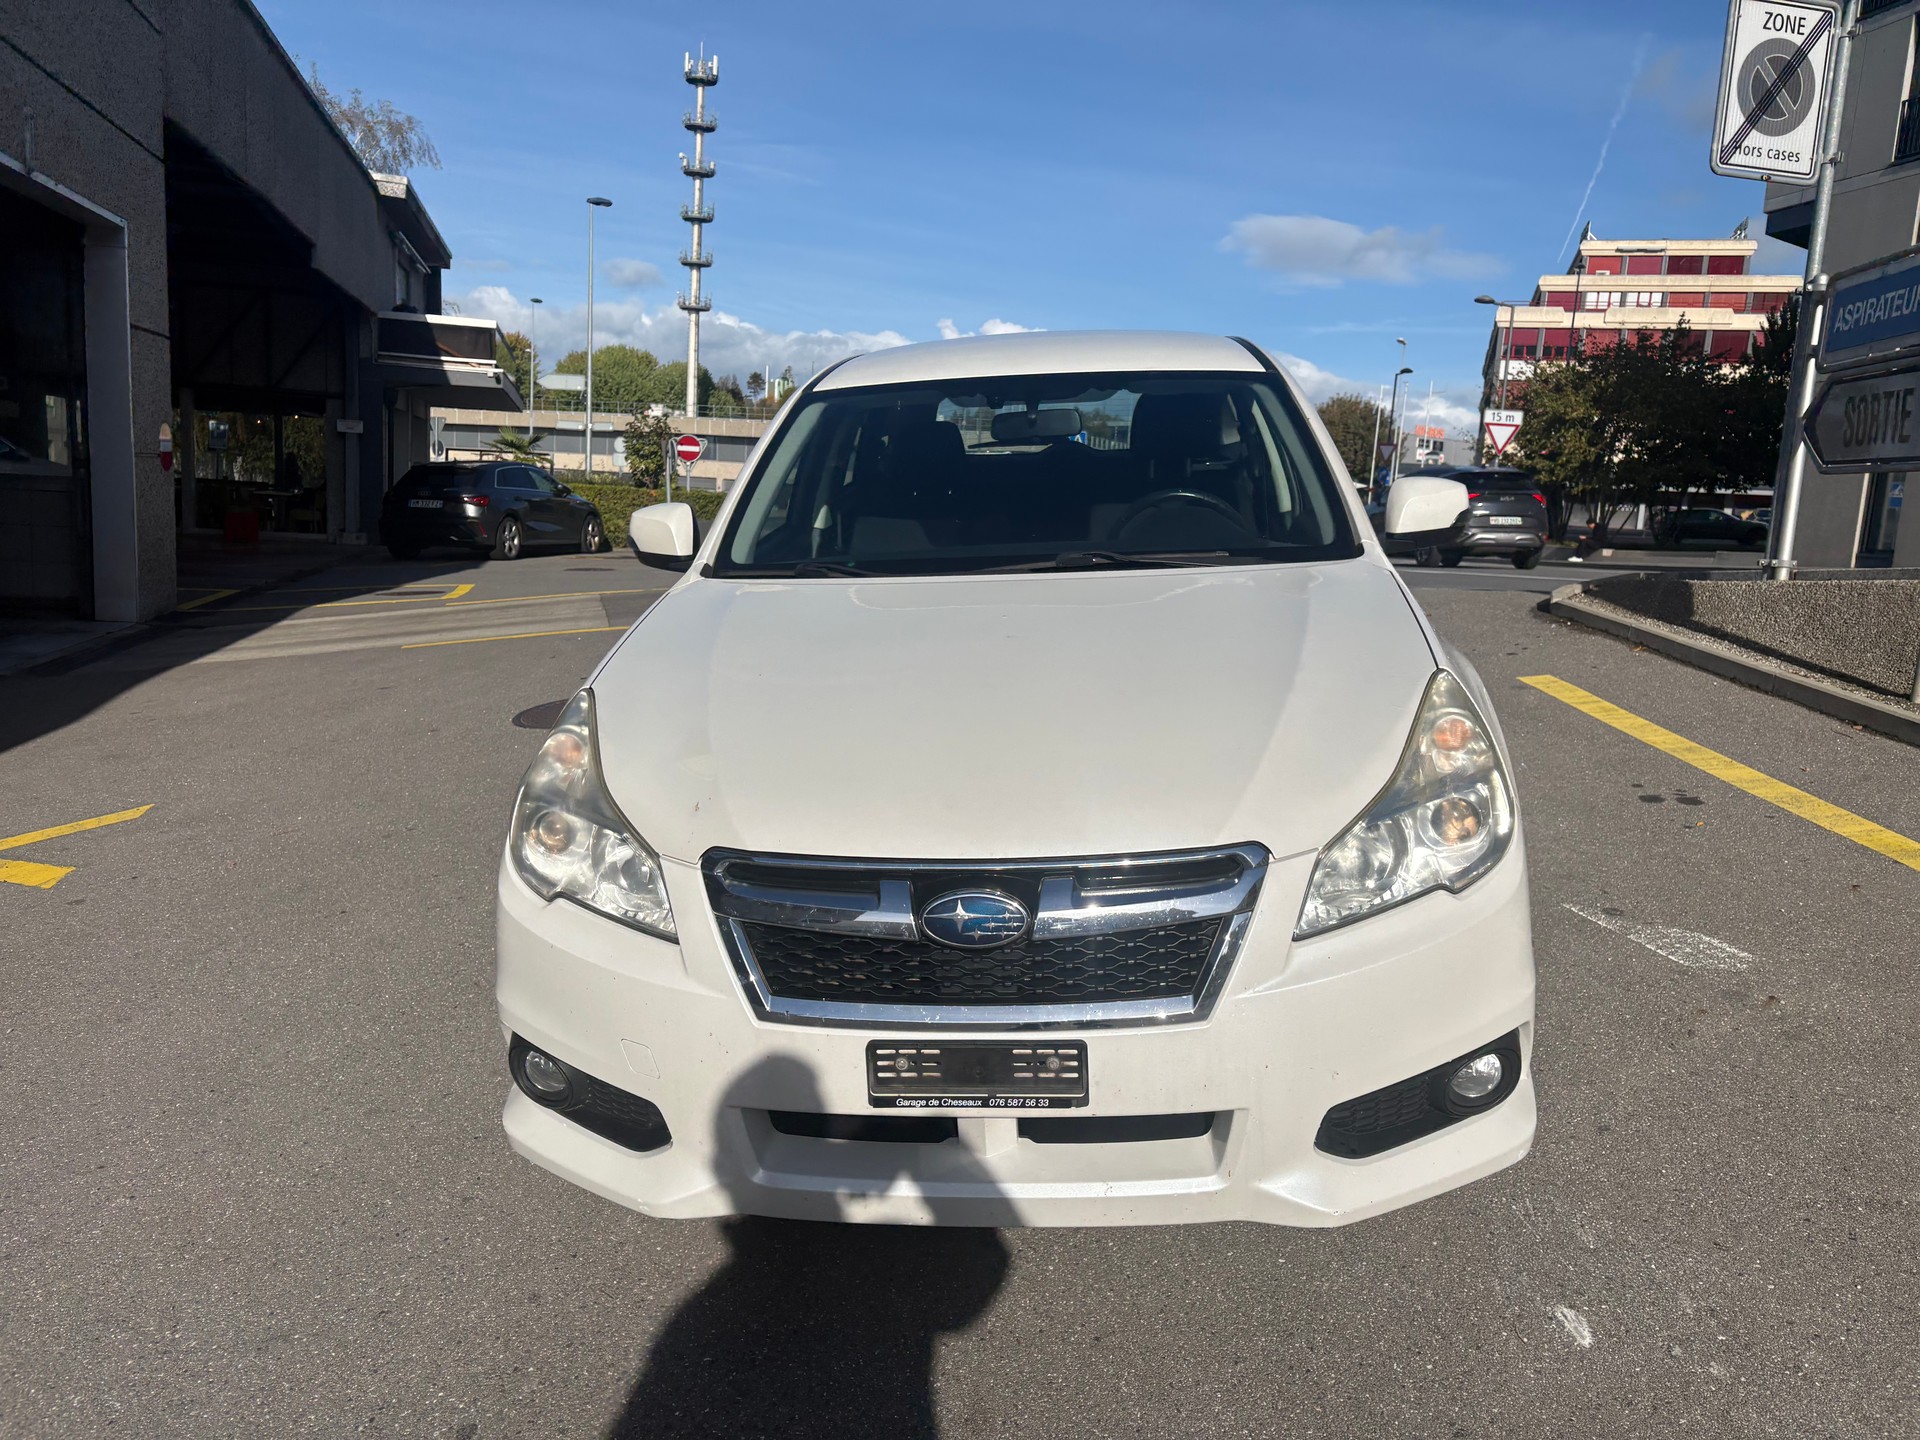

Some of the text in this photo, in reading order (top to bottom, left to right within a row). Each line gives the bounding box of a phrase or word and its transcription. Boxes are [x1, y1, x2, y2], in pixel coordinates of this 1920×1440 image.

[1762, 11, 1807, 36] ZONE
[1766, 149, 1801, 163] cases
[1491, 412, 1515, 423] 15 m
[1842, 387, 1915, 448] SORTIE
[896, 1098, 1049, 1108] Garage de Cheseaux 076 587 56 33
